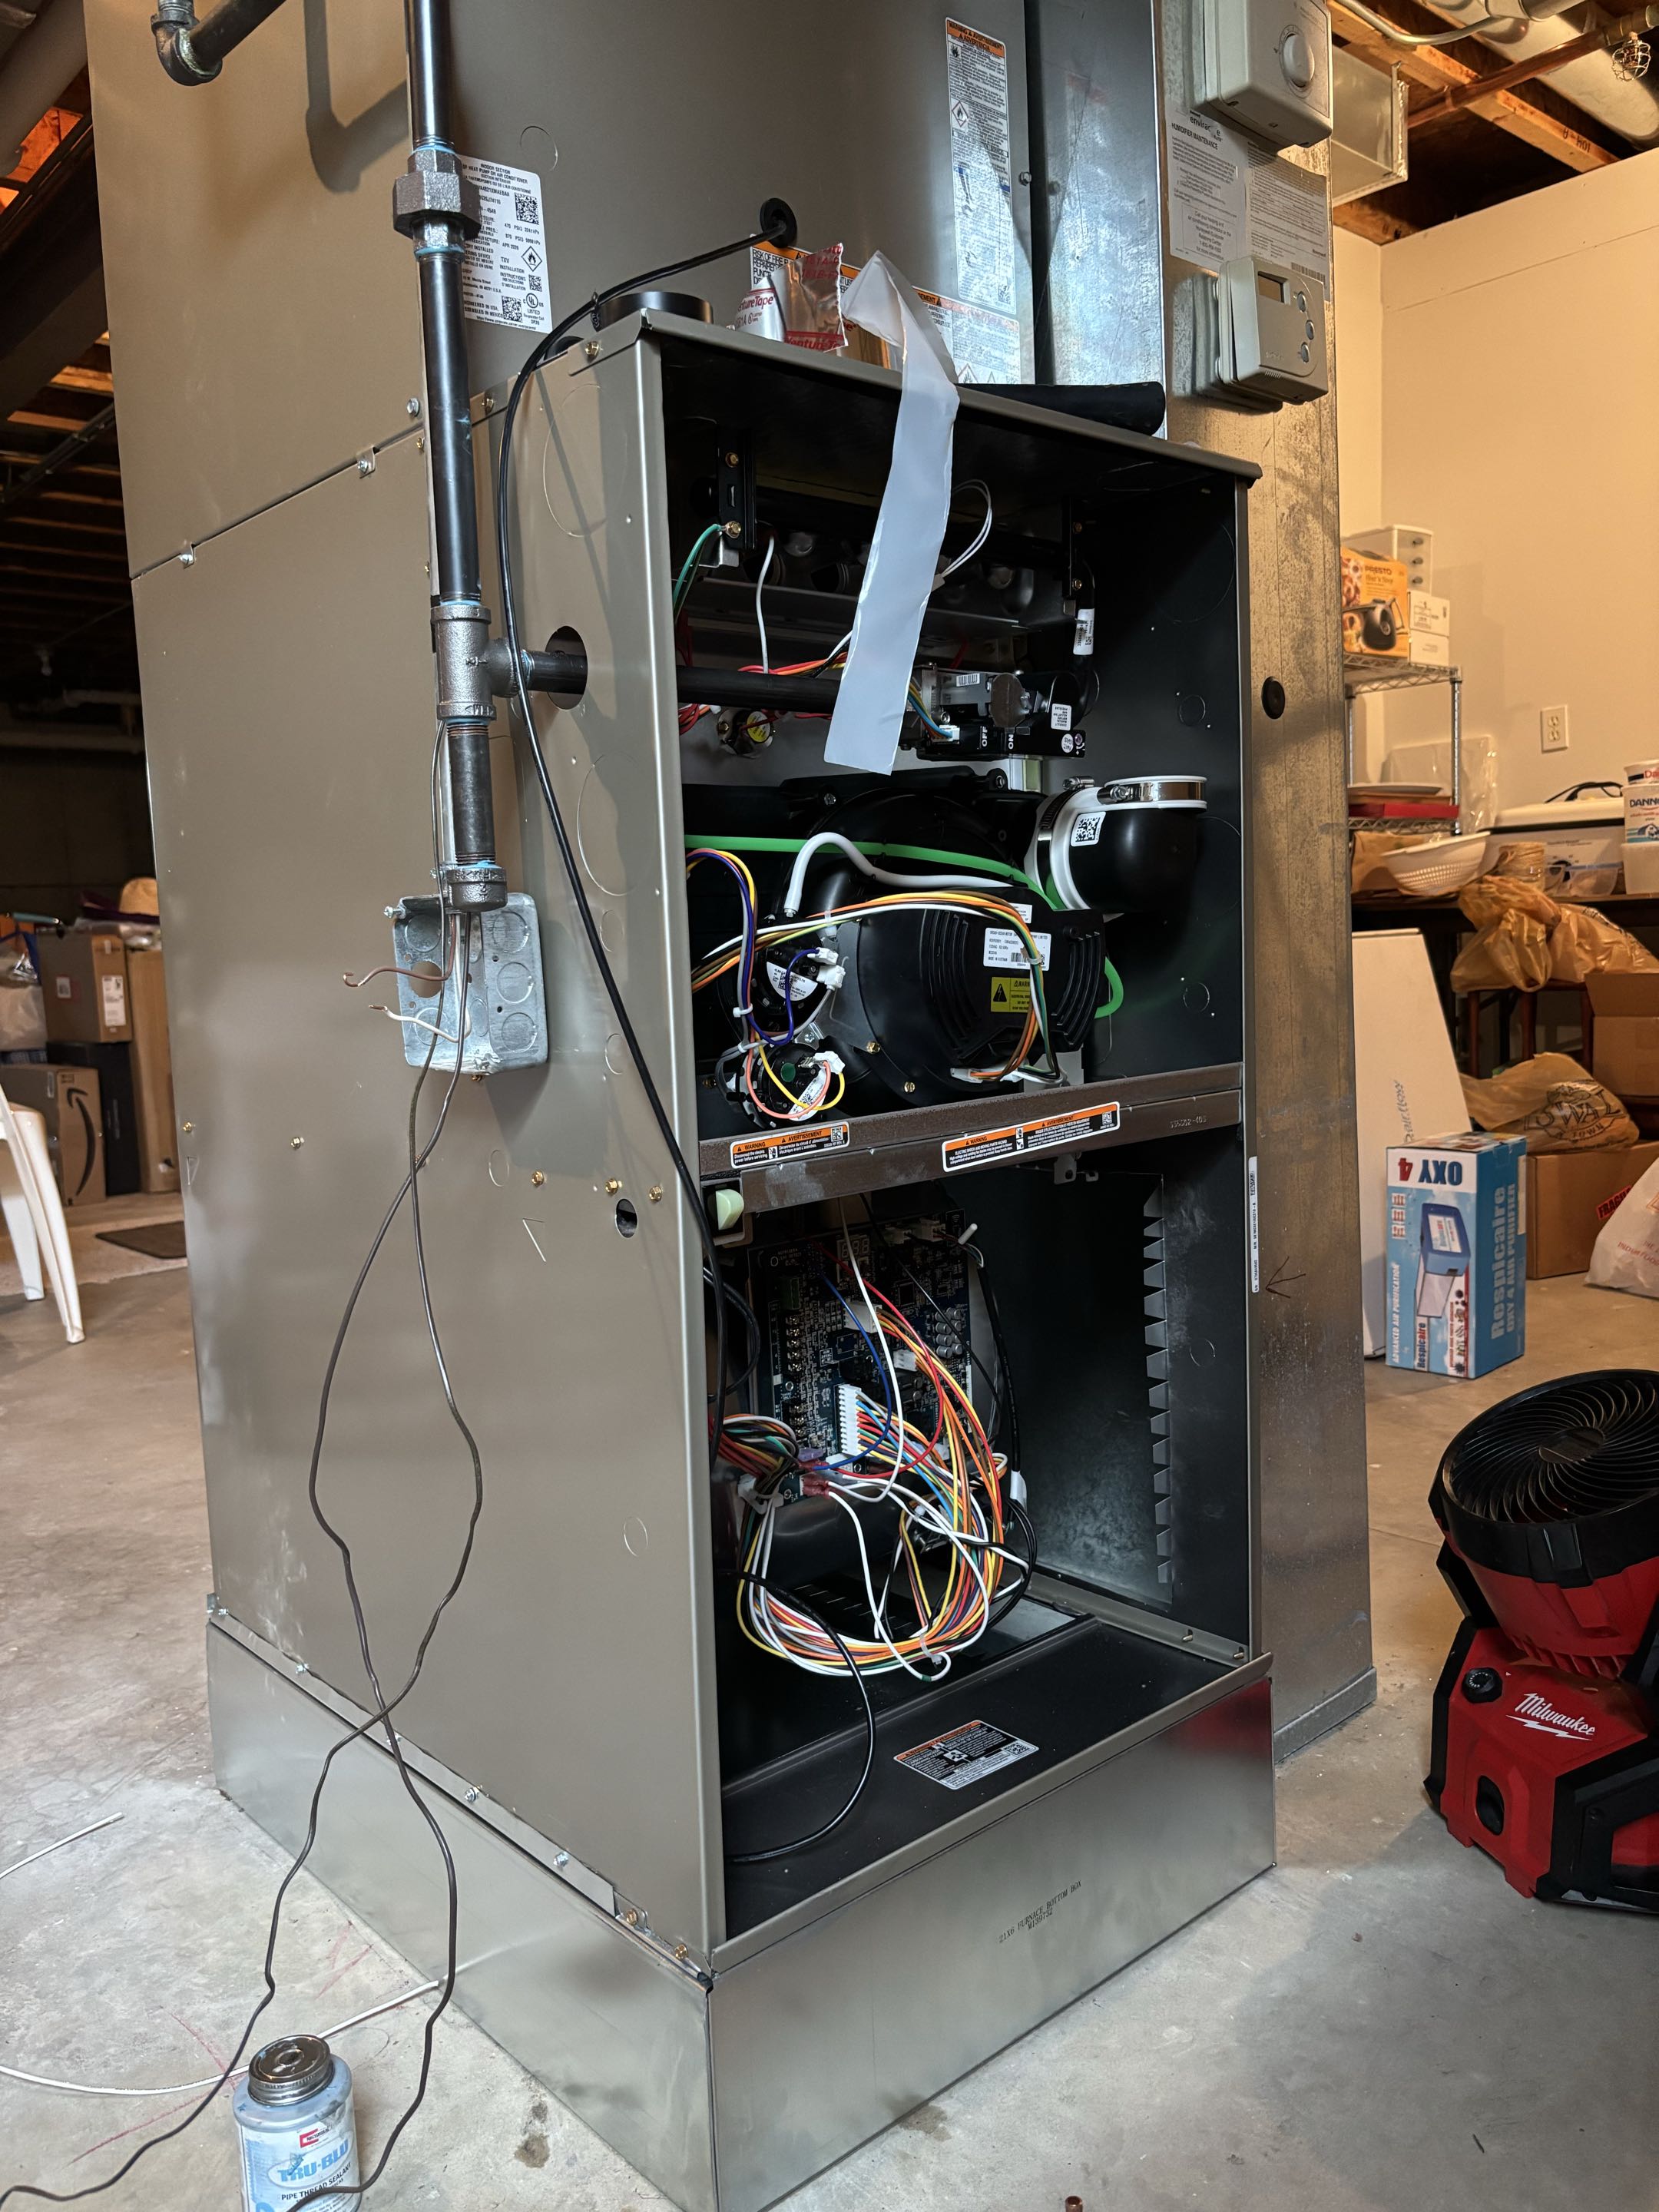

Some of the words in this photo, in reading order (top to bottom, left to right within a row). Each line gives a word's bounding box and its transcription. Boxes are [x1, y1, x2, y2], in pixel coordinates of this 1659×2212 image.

[1171, 123, 1193, 137] HUMIDIFIER
[1193, 132, 1218, 150] MAINTENANCE
[504, 174, 528, 184] CONDITIONER
[499, 264, 525, 273] INSTALLATION
[753, 249, 764, 259] RISK
[765, 252, 772, 261] OF
[773, 255, 783, 265] FIRE
[500, 272, 526, 281] INSTRUCTIONS
[1008, 734, 1014, 750] ON
[1629, 797, 1659, 807] DANN
[744, 1141, 766, 1151] WARNING
[788, 1131, 822, 1142] AVERTISSEMENT
[1398, 1157, 1413, 1181] 4
[1418, 1159, 1462, 1186] OXY
[1506, 1183, 1515, 1257] PURIFIER
[1491, 1187, 1505, 1339] Respicaire
[1506, 1257, 1515, 1285] AIR
[1392, 1263, 1400, 1313] PURIFICATION
[1506, 1287, 1515, 1298] 4
[1506, 1303, 1515, 1333] OXY
[1416, 1323, 1426, 1369] Respicaire
[1515, 1693, 1595, 1735] Milwaukee
[999, 1926, 1015, 1943] 21X6
[1018, 1906, 1044, 1930] FURNACE
[1046, 1889, 1068, 1909] BOTTOM
[1070, 1879, 1081, 1893] BOX
[277, 2139, 349, 2182] TRU-BLU
[281, 2192, 298, 2201] PIPE
[299, 2181, 328, 2198] THREAD
[328, 2162, 352, 2186] SEALANT
